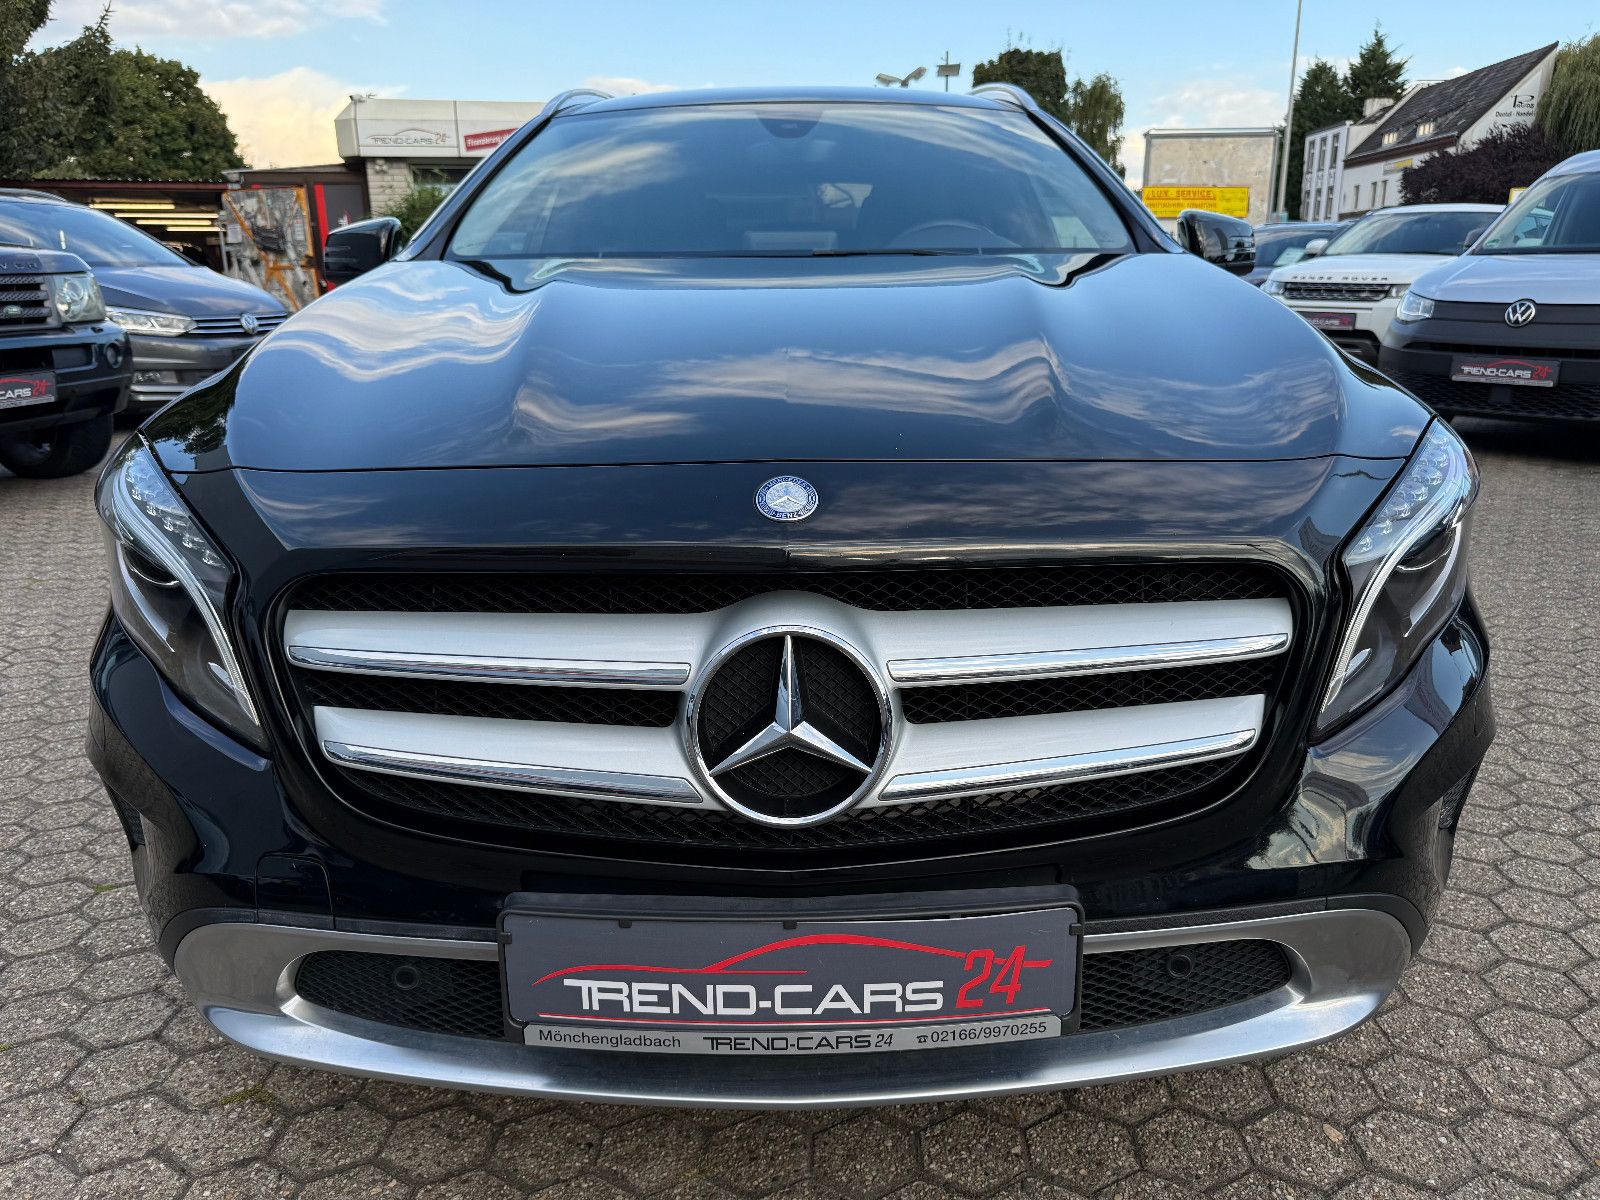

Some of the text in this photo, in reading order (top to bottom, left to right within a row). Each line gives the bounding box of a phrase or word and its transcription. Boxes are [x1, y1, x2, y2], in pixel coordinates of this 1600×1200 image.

[1176, 190, 1214, 198] SERVICE
[1461, 365, 1549, 380] TREND-CARS 24
[563, 945, 1027, 1015] TREND-CARS 24
[539, 1021, 1047, 1051] Mönchengladbach TREND-CARS 24 02166/9970255
